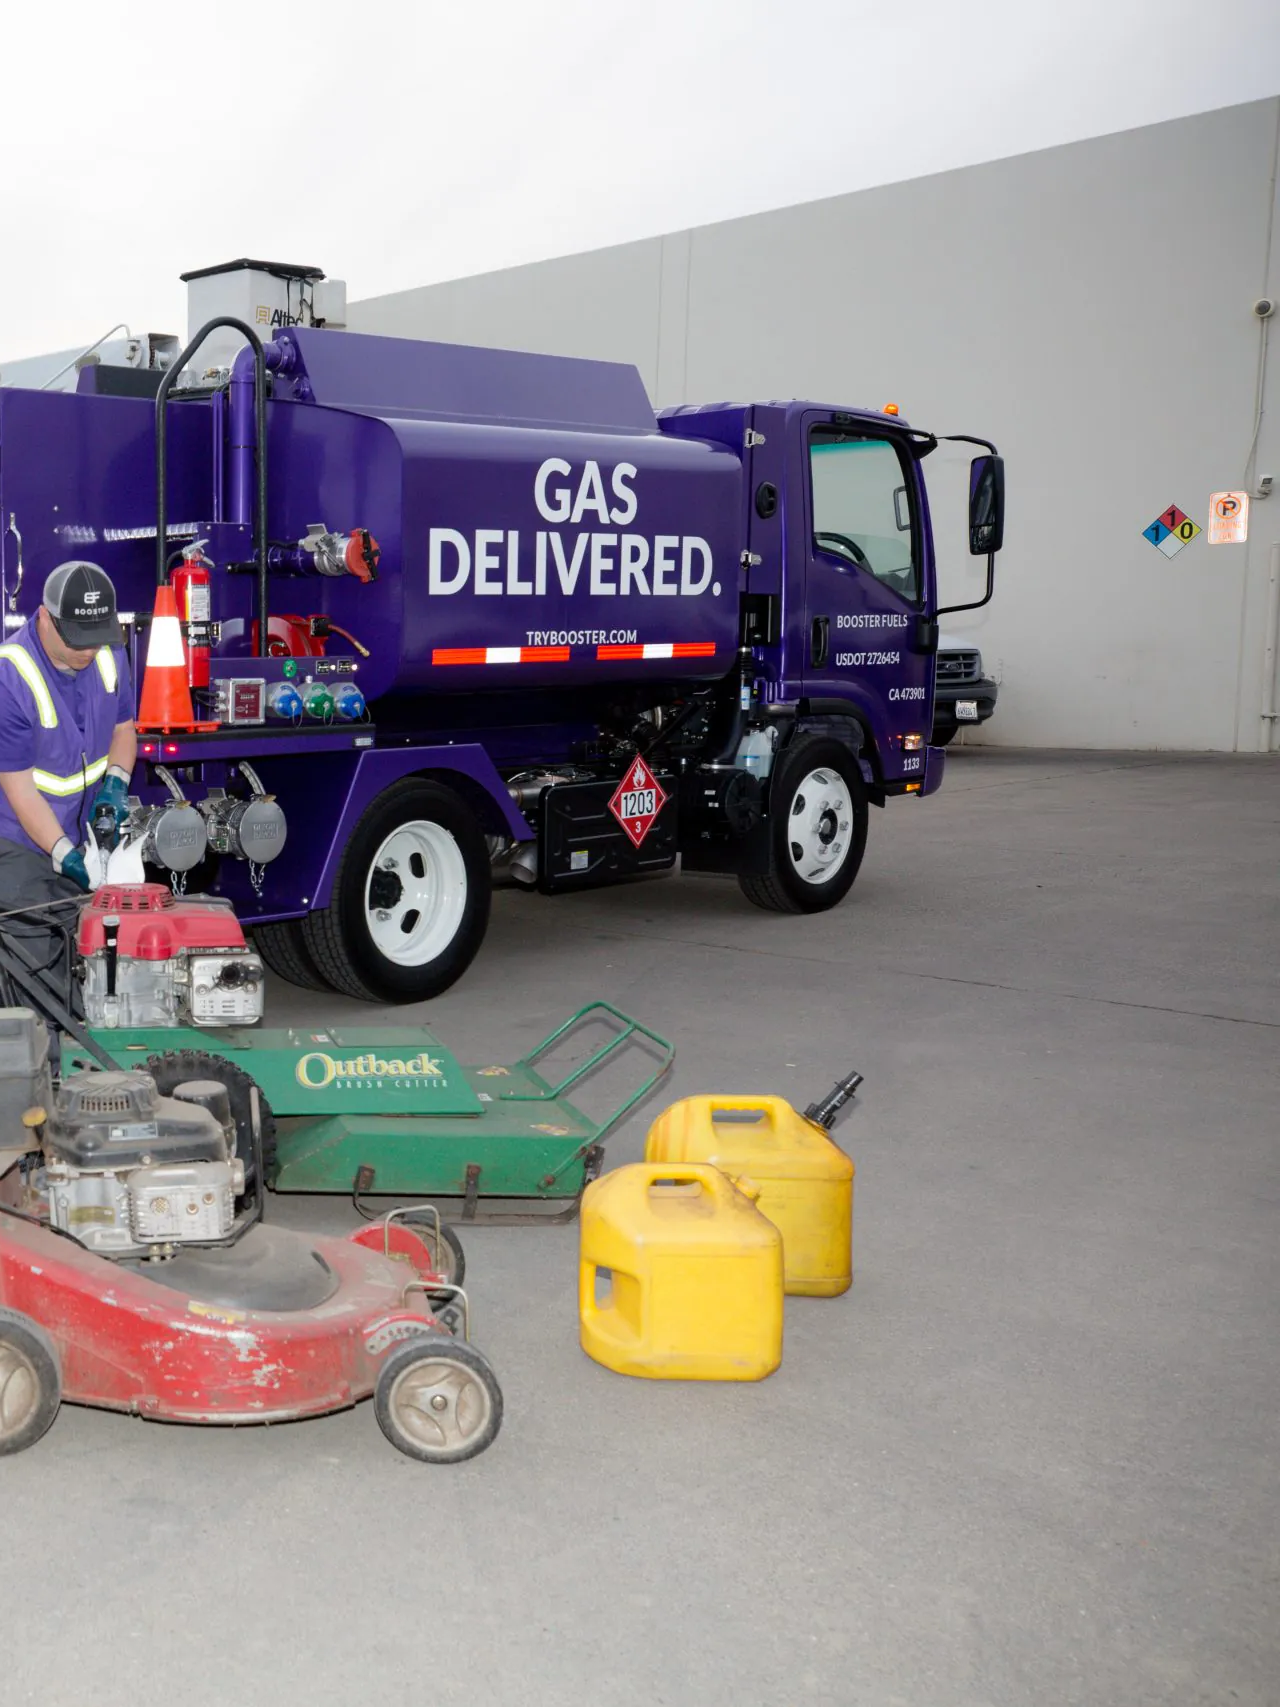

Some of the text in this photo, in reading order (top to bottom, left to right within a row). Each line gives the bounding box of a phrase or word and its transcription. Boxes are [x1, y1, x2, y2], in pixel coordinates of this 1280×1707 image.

[534, 457, 638, 525] GAS
[1167, 510, 1176, 527] 1
[1151, 525, 1160, 541] 1
[1180, 522, 1193, 539] 0
[428, 527, 722, 597] DELIVERED.
[74, 606, 109, 616] BOOSTER
[837, 614, 908, 628] BOOSTER FUELS
[526, 630, 637, 645] TRYBOOSTER.COM
[836, 651, 900, 666] USDOT 2726454
[888, 687, 925, 701] CA 473901
[903, 757, 920, 771] 1133
[623, 790, 654, 817] 1203
[635, 821, 642, 834] 3
[296, 1052, 443, 1090] Outback
[336, 1079, 448, 1089] BRUSH CUTTER
